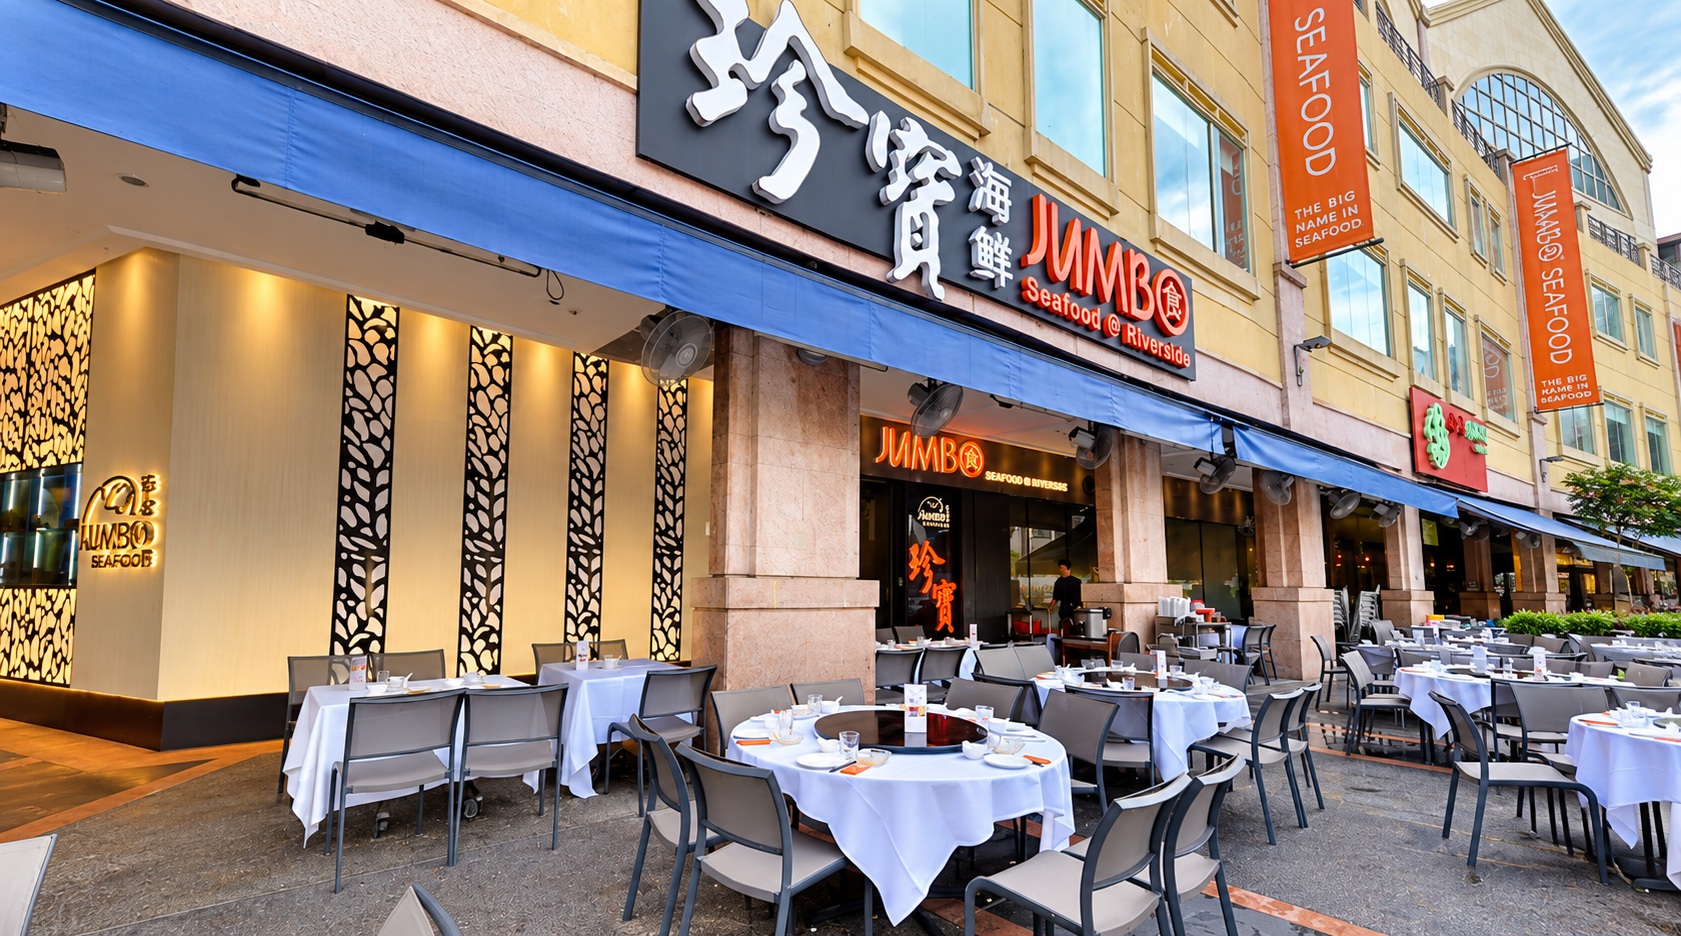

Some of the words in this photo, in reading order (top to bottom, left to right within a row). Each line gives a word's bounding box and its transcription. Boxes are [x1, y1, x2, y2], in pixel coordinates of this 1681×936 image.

[1294, 7, 1336, 176] SEAFOOD
[968, 156, 1014, 289] 海鮮
[1295, 202, 1321, 219] THE
[1328, 190, 1355, 208] BIG
[1296, 211, 1337, 233] NAME
[1342, 204, 1359, 218] IN
[1020, 193, 1190, 337] JUMBO
[1021, 276, 1101, 331] Seafood
[1103, 314, 1121, 338] @
[1122, 323, 1190, 369] Riverside
[1541, 267, 1573, 364] SEAFOOD
[1567, 374, 1587, 384] BIG
[874, 426, 984, 478] JUMBO
[985, 470, 1023, 486] SEAFOOD
